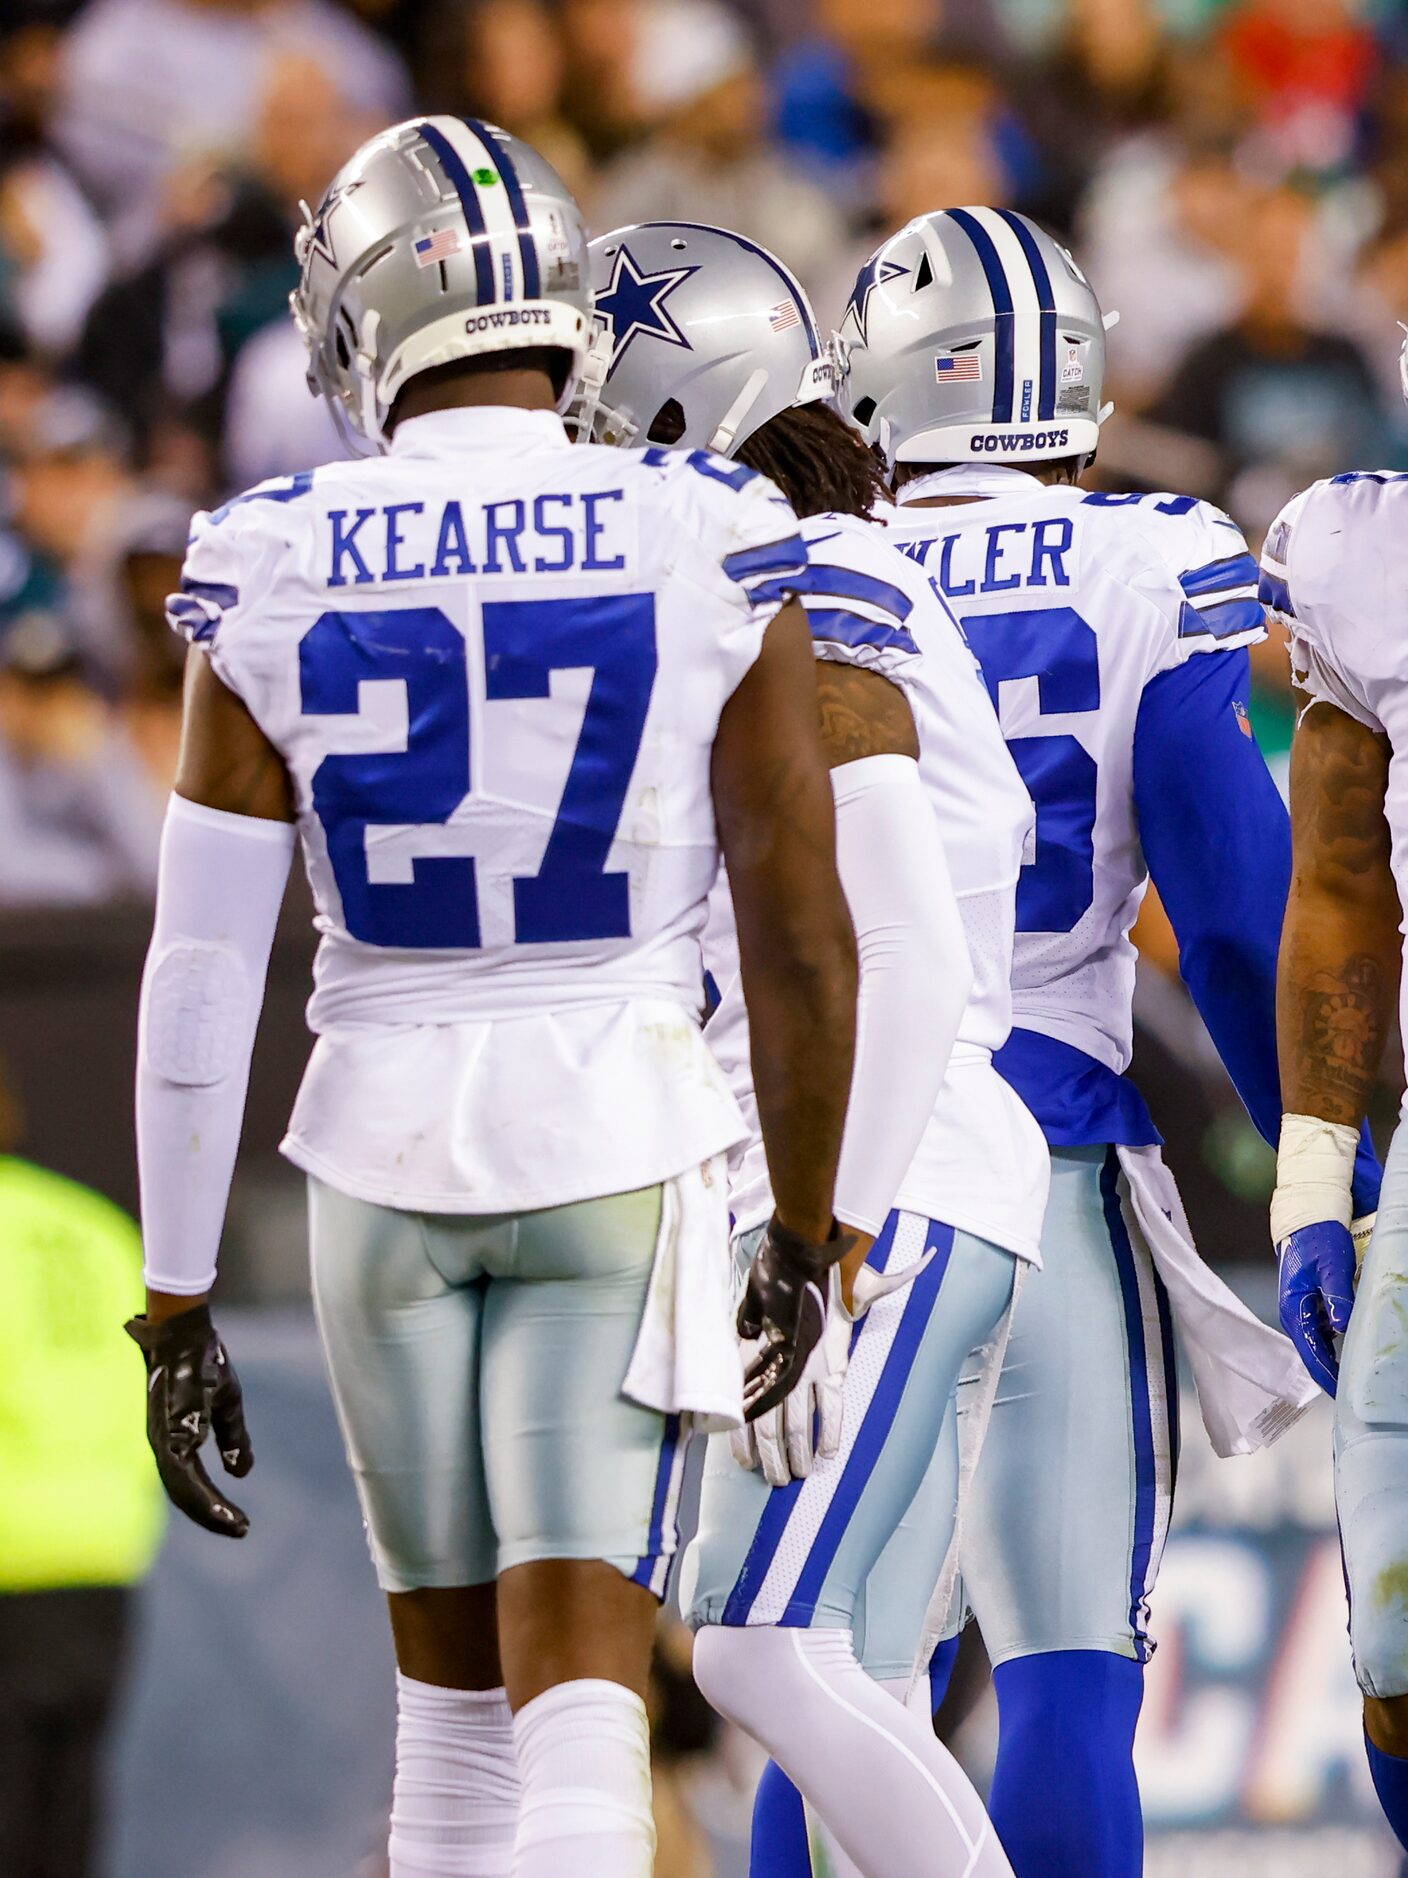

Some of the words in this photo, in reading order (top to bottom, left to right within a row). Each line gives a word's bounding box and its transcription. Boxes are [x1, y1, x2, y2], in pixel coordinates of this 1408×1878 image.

[465, 310, 551, 334] COWBOYS
[1022, 381, 1032, 418] FOWLER
[970, 429, 1069, 452] COWBOYS
[327, 489, 625, 587] KEARSE
[299, 591, 658, 948] 27
